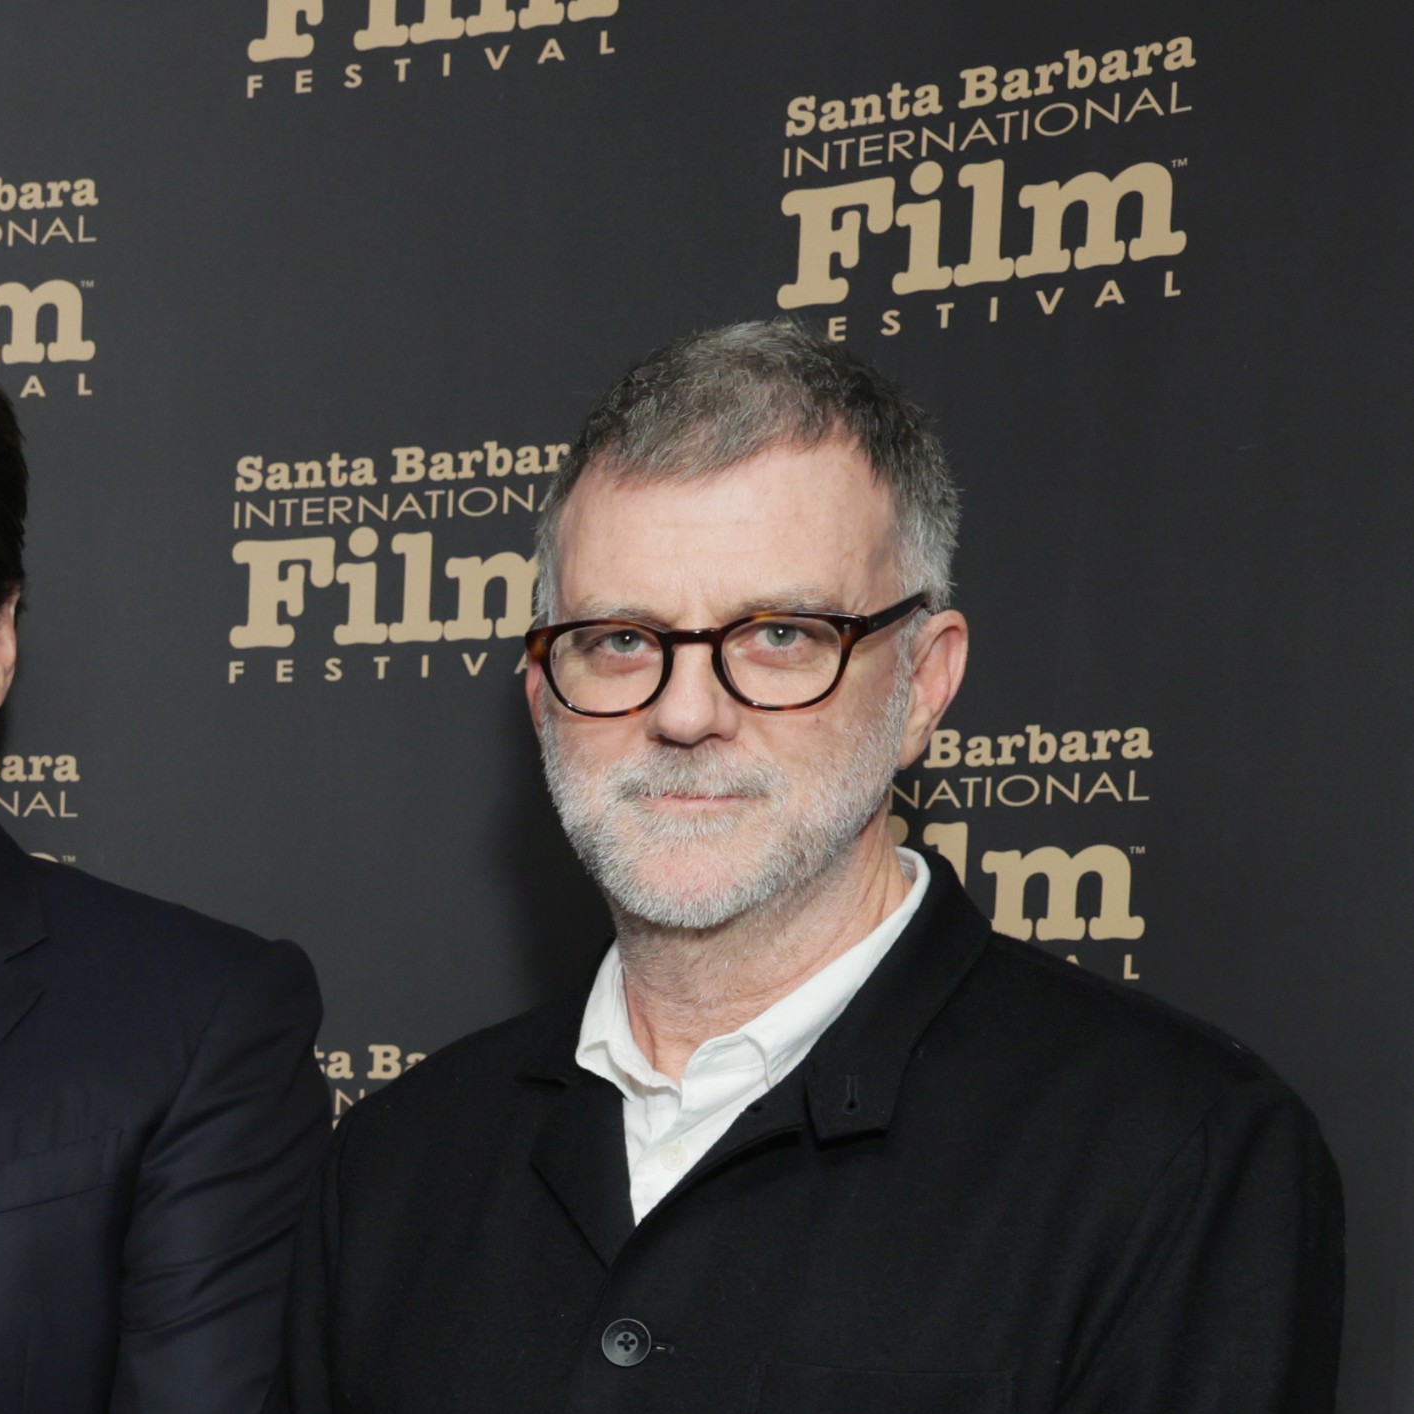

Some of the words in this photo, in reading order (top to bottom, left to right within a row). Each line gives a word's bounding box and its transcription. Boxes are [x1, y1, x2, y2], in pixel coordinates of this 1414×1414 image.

[247, 31, 614, 98] FESTIVAL
[786, 68, 942, 137] Santa
[960, 37, 1196, 109] Barbara
[784, 82, 1191, 177] INTERNATIONAL
[776, 159, 1187, 310] Film
[828, 271, 1180, 342] ESTIVAL
[236, 453, 377, 491] Santa
[391, 440, 571, 483] Barbar
[234, 484, 545, 528] INTERNATION
[923, 725, 1153, 767] Barbara
[889, 769, 1150, 810] NATIONAL
